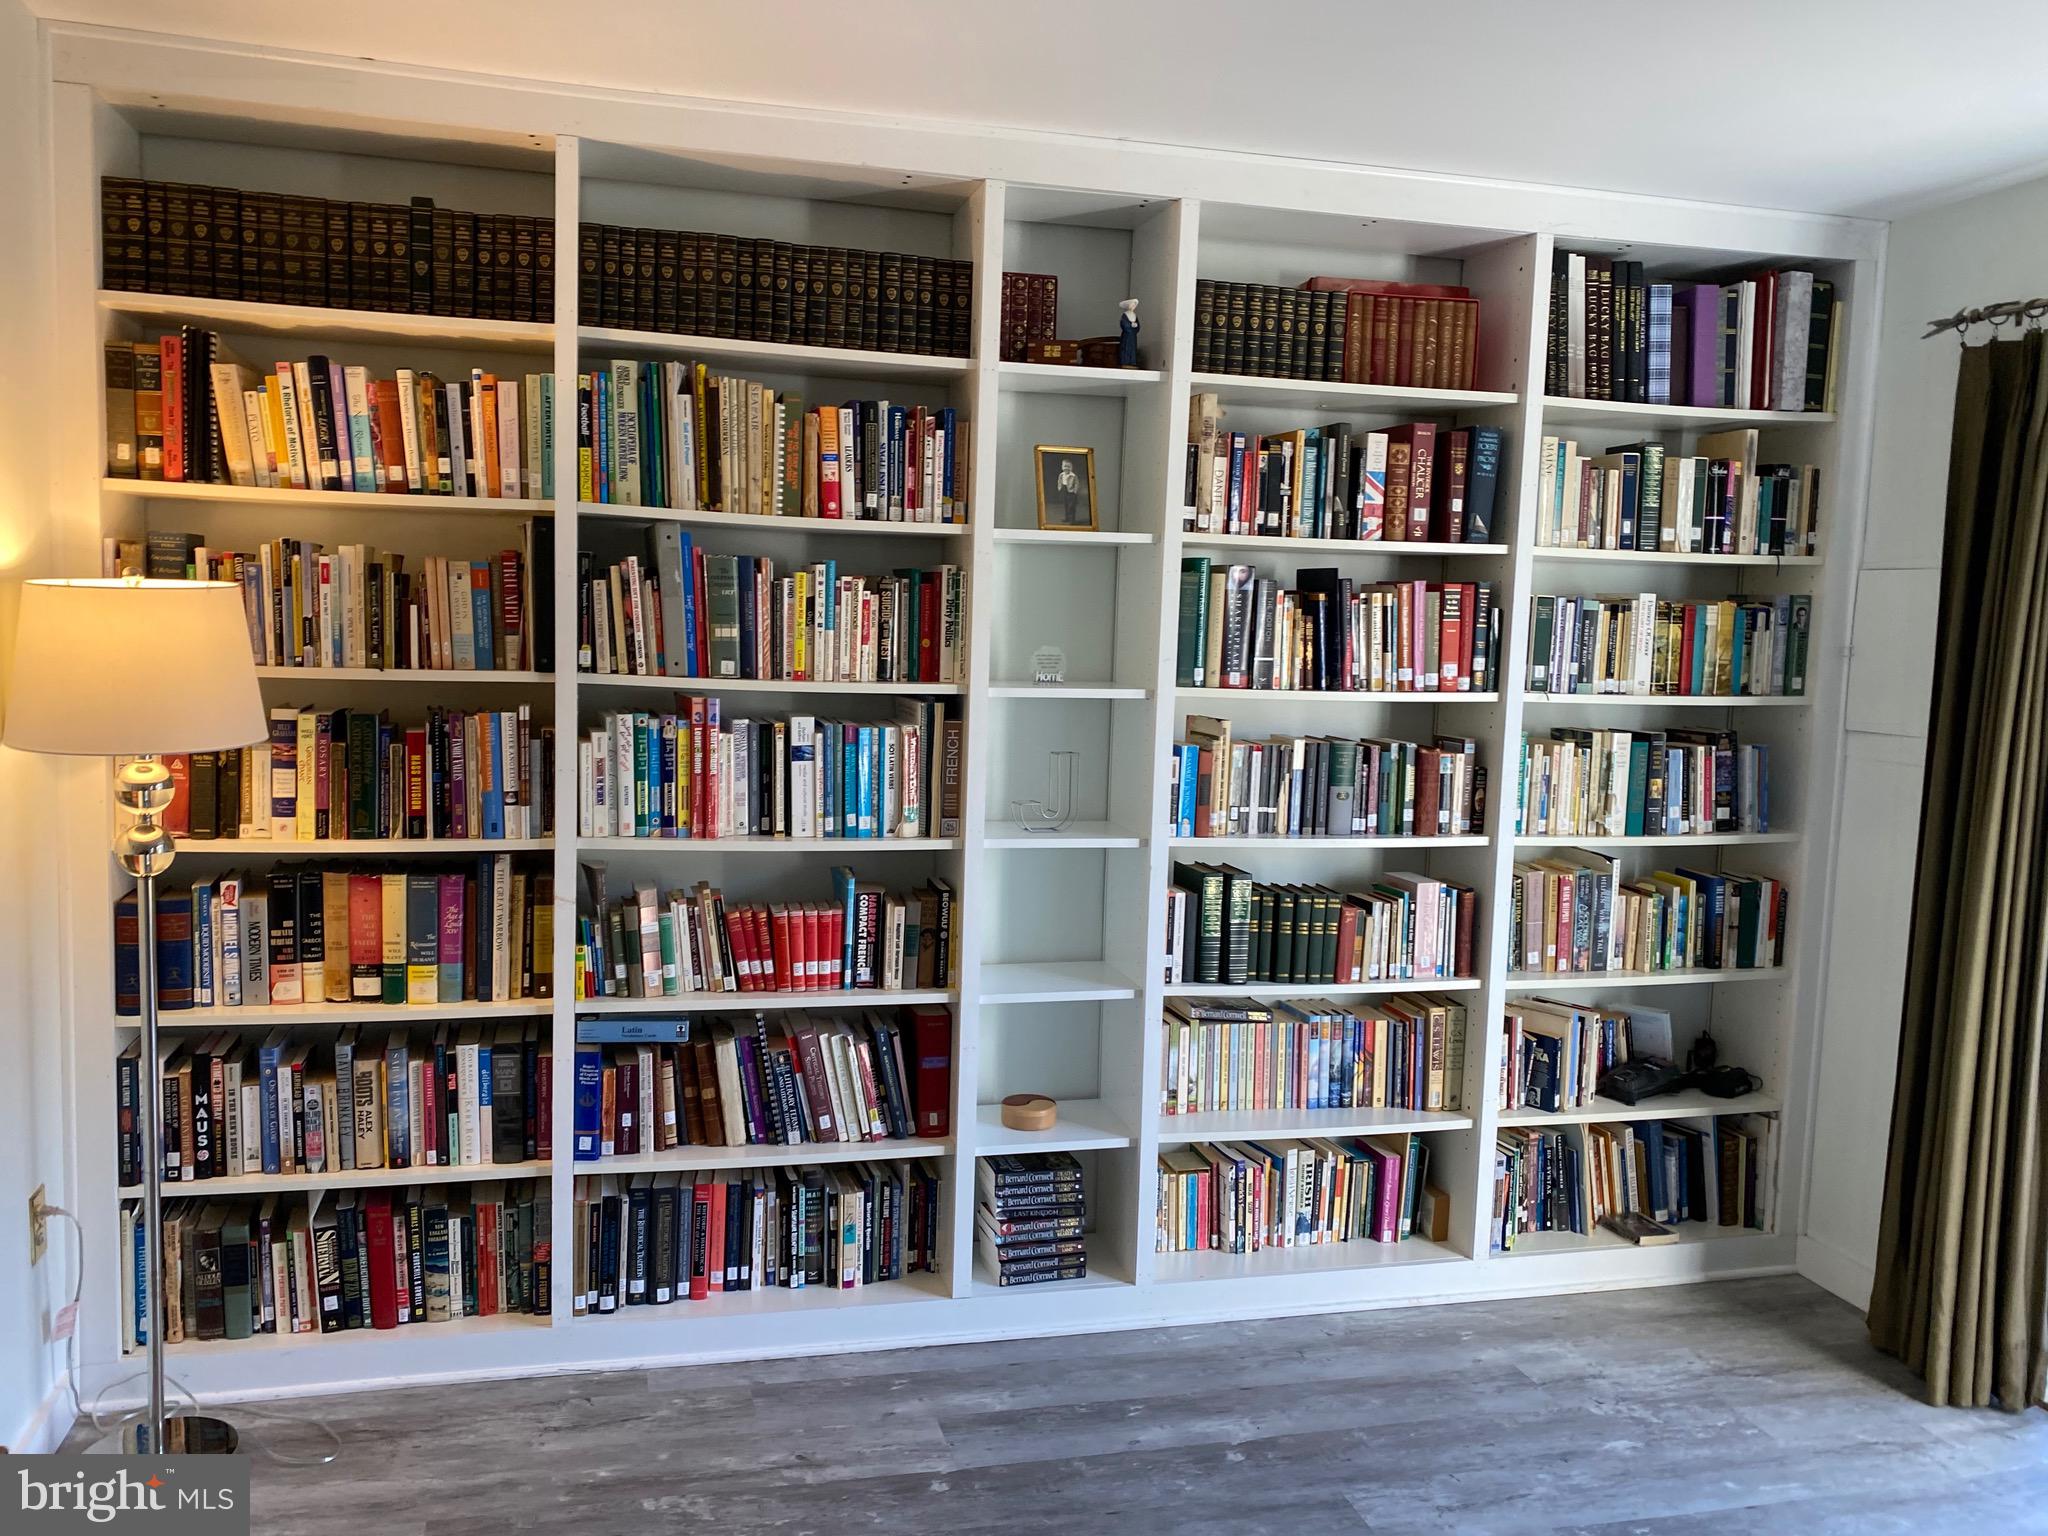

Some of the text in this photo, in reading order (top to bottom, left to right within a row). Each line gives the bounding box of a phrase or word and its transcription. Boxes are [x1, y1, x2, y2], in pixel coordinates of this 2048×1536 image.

[1559, 295, 1567, 330] LUCKY
[1559, 336, 1567, 356] BAG
[1589, 288, 1597, 384] LUCKY BAG 1992
[1601, 290, 1609, 386] LUCKY BAG 1992
[281, 393, 293, 423] Rhetoric
[580, 403, 589, 435] Football
[751, 386, 759, 431] SEA AIR
[248, 413, 259, 441] PLATO
[286, 425, 294, 435] of
[318, 417, 330, 444] LOGIC
[627, 412, 636, 459] ENCYCLOPEDIA
[288, 438, 298, 467] Motives
[618, 412, 628, 482] MODERN BODYBUILDING
[845, 445, 853, 472] LEADERS
[1305, 449, 1316, 461] The
[1545, 442, 1554, 477] MAINE
[1214, 470, 1224, 506] DANTE
[1304, 462, 1316, 498] Madwoman
[1415, 449, 1426, 499] CHAUCER
[1304, 506, 1314, 517] the
[503, 559, 519, 623] TRIUMPH
[461, 609, 467, 619] IN
[881, 591, 891, 661] SUICIDE WEST
[944, 599, 955, 648] Dirty Politics
[1232, 594, 1242, 671] SHAKESPEARE
[1373, 606, 1381, 660] Paradise Lost
[694, 712, 703, 722] 3
[710, 712, 717, 722] 4
[506, 716, 516, 790] MOTHER ANGELICA
[694, 728, 702, 748] Learn
[319, 739, 327, 778] ROSARY
[410, 755, 422, 775] MASS
[451, 739, 464, 781] FAMILY VALUES
[946, 730, 960, 785] FRENCH
[495, 868, 504, 952] THE GREAT WARBOW
[868, 895, 877, 943] HARRAP'S
[941, 893, 949, 929] BEOWULF
[201, 923, 210, 946] LIQUID
[223, 913, 239, 985] MICHAEL SAVAGE
[856, 895, 868, 974] COMPACT FRENCH
[202, 946, 210, 986] MODERNITY
[248, 921, 262, 982] MODERN TIMES
[622, 1026, 643, 1034] Latin
[1431, 1037, 1440, 1071] LEWIS
[213, 1064, 221, 1081] TIME
[213, 1083, 221, 1093] TO
[293, 1072, 302, 1098] JARHEAD
[391, 1053, 402, 1119] SARAH PALIN
[481, 1069, 490, 1105] deliberate
[213, 1094, 222, 1120] BETRAY
[336, 1053, 351, 1137] DAVID BRINKLEY
[355, 1071, 373, 1132] ROOTS ALEX
[785, 1074, 799, 1132] LITERARY TERMS
[172, 1118, 178, 1128] OF
[195, 1093, 209, 1147] MAUS
[229, 1114, 237, 1136] MEN'S
[357, 1111, 366, 1139] HALEY
[1005, 1173, 1054, 1184] Bernard Cornwell
[1007, 1184, 1053, 1194] Bernard Cornwell
[1304, 1163, 1313, 1208] IRISH
[1008, 1195, 1056, 1206] Bernard Cornwell
[410, 1206, 418, 1227] THOMAS
[1011, 1222, 1058, 1232] Bernard Cornwell
[411, 1234, 420, 1250] RICKS
[636, 1220, 644, 1250] RHETORICAL
[1006, 1232, 1053, 1243] Bernard Cornwell
[315, 1230, 339, 1286] SHERMAN
[413, 1252, 422, 1279] CHURCHILL
[636, 1251, 644, 1278] TRADITION
[1008, 1245, 1056, 1257] Bernard Cornwell
[1011, 1258, 1058, 1271] Bernard Cornwell
[358, 1248, 369, 1290] DERELICTION
[1010, 1271, 1057, 1284] Bernard Cornwell
[414, 1286, 423, 1305] ORWELL
[539, 1266, 547, 1307] JOHN FEINSTEIN
[361, 1298, 370, 1314] DUTY
